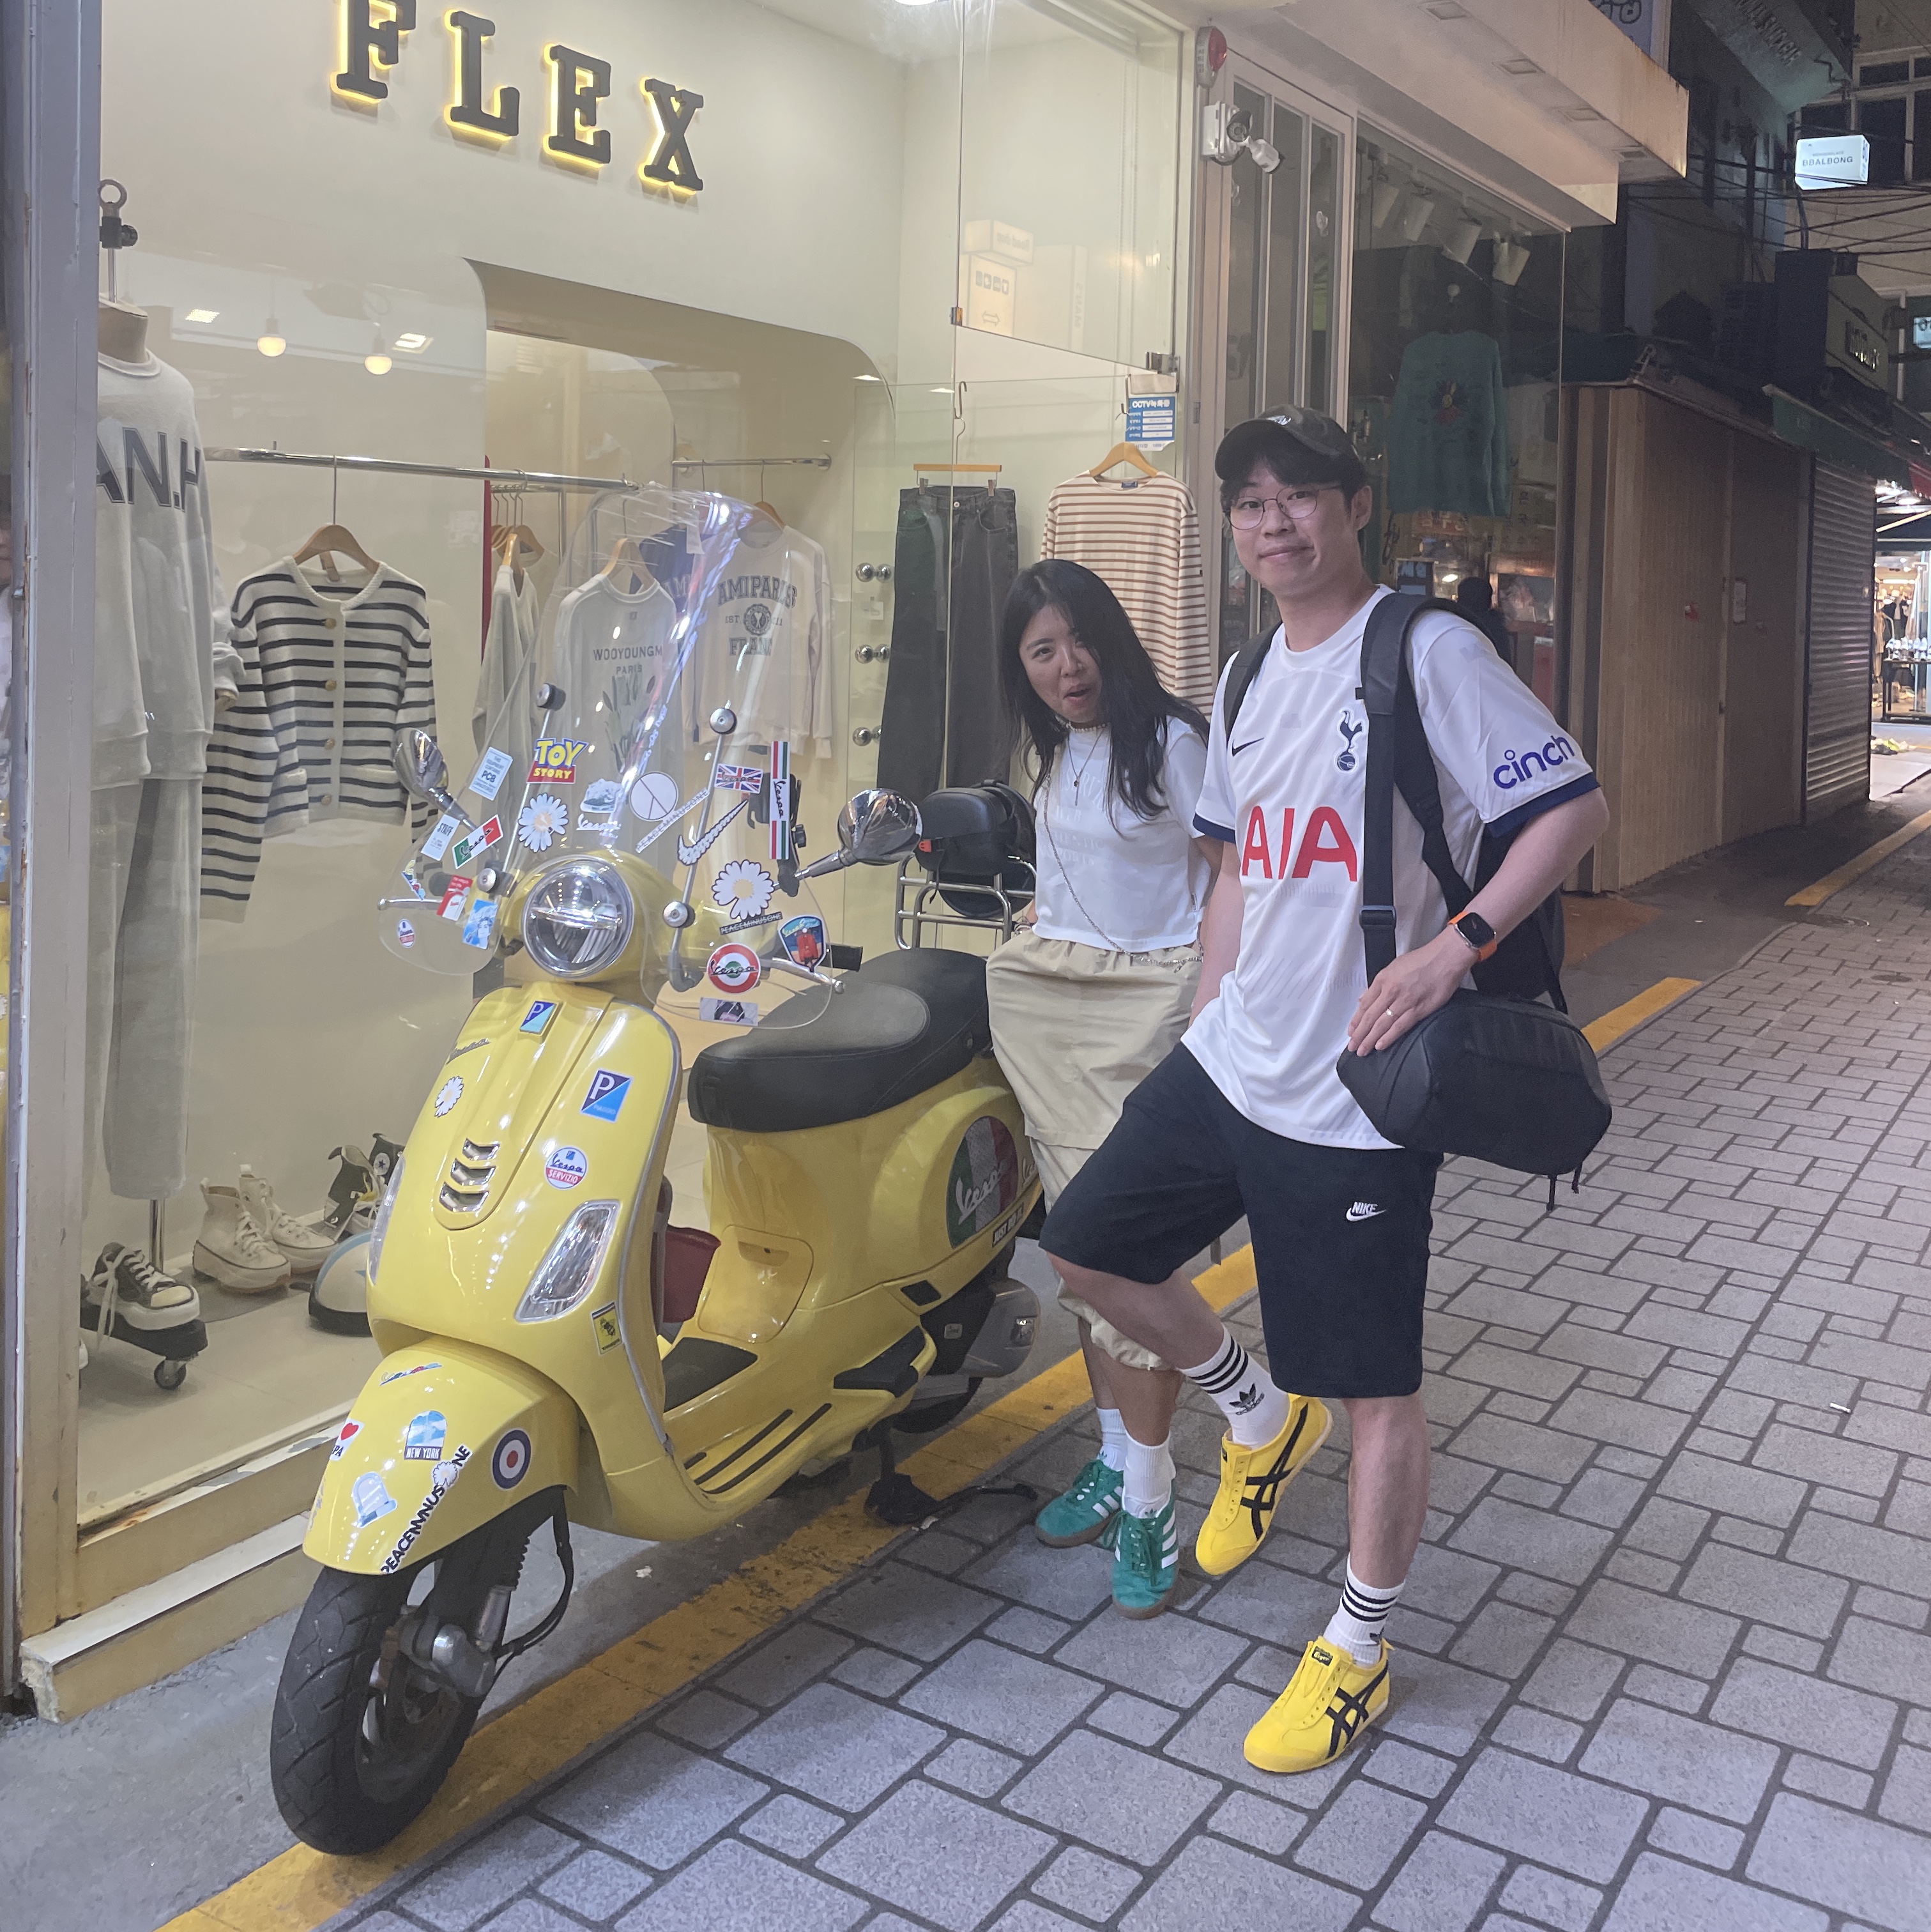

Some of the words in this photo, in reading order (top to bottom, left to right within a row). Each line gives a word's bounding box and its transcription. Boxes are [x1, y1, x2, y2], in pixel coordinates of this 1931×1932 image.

[334, 0, 704, 192] FLEX
[1802, 156, 1854, 167] BBALBONG
[616, 664, 643, 675] PARIS
[537, 739, 586, 767] TOY
[1493, 735, 1576, 789] cinch
[482, 770, 496, 783] PCB
[533, 767, 572, 779] STORY
[773, 779, 787, 819] Vespa
[1242, 805, 1358, 882] AIA
[710, 959, 759, 976] Vespa
[526, 1002, 544, 1021] P
[590, 1073, 615, 1100] P
[550, 1153, 584, 1174] Vespa
[547, 1169, 579, 1186] SERVIZIO
[1351, 1201, 1378, 1215] NIKE
[406, 1447, 420, 1459] NEW
[423, 1448, 440, 1459] YORK
